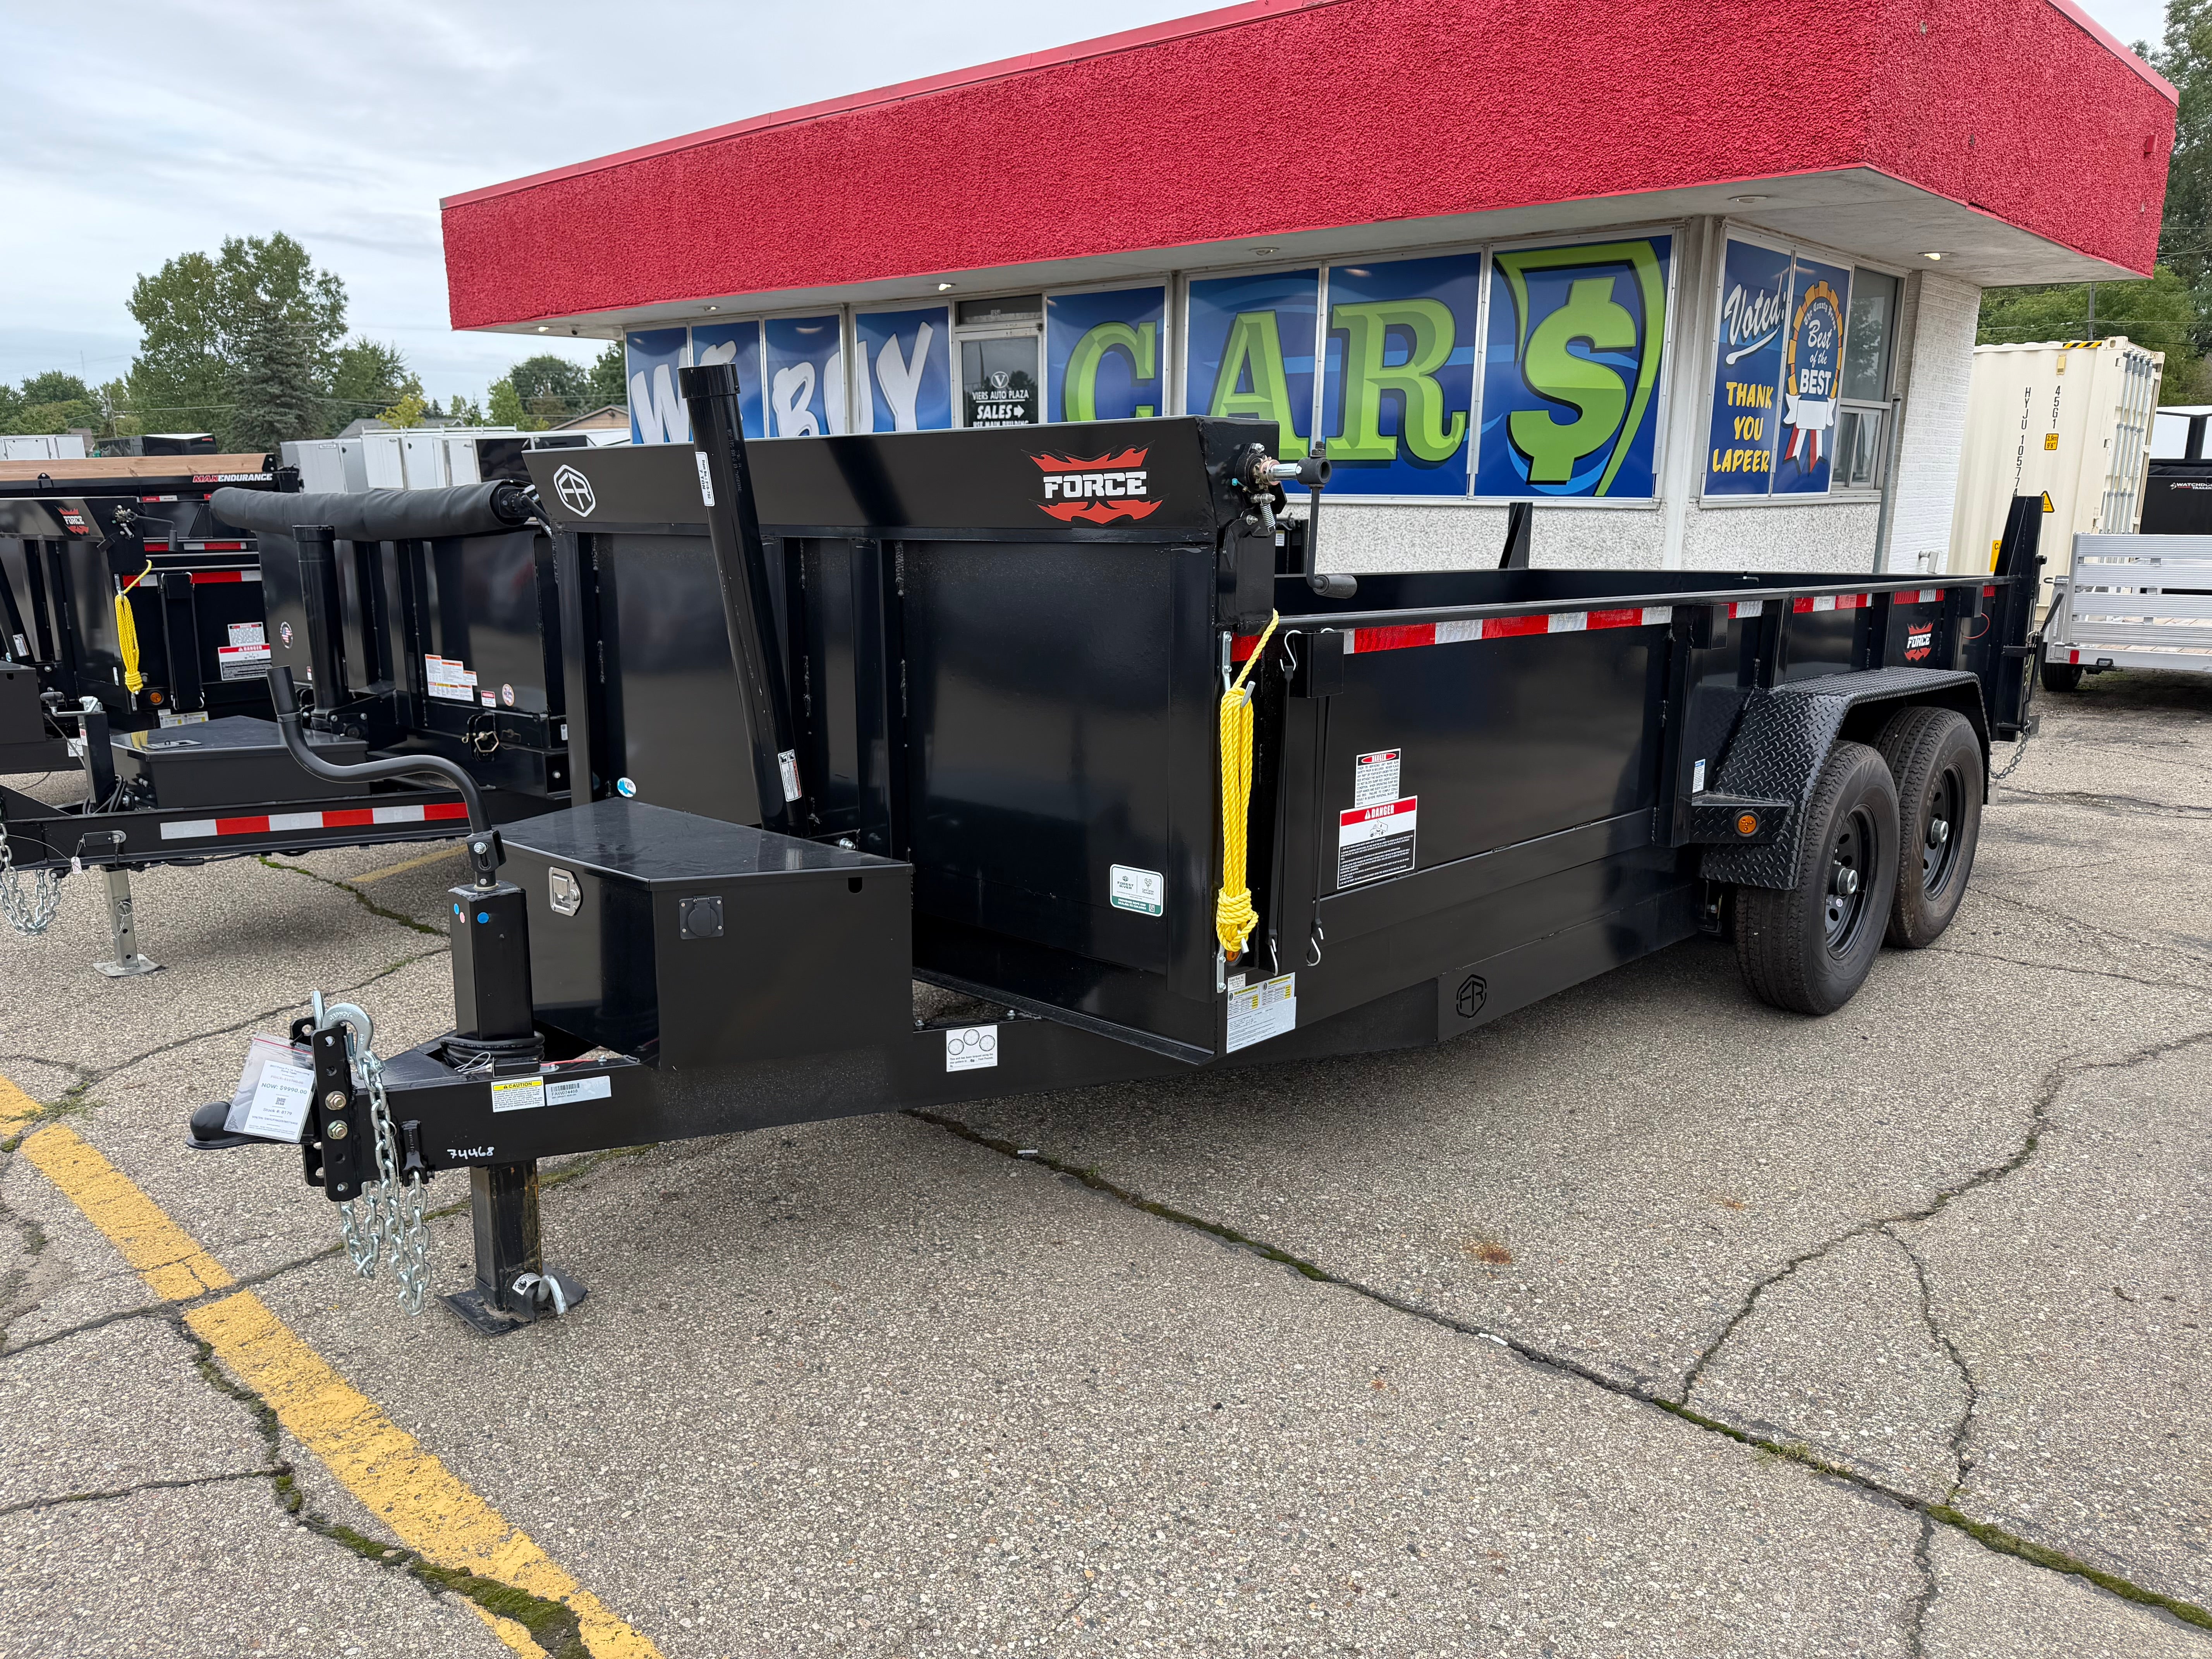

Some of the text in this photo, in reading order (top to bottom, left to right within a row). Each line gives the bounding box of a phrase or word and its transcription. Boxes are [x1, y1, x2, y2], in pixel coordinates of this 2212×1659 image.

[1808, 319, 1832, 349] Best
[1810, 350, 1827, 368] of the
[1800, 369, 1831, 395] BEST
[972, 390, 1029, 400] VIERS AUTO PLAZA
[1726, 381, 1774, 409] THANK
[977, 405, 1013, 419] SALES
[1734, 416, 1764, 441] YOU
[1712, 448, 1770, 473] LAPEER
[1043, 471, 1147, 498] FORCE
[63, 515, 85, 525] FORCE
[1907, 633, 1931, 649] FORCE
[1371, 804, 1394, 818] DANGER
[280, 1085, 307, 1094] $9990.00
[447, 1146, 495, 1160] 74468
